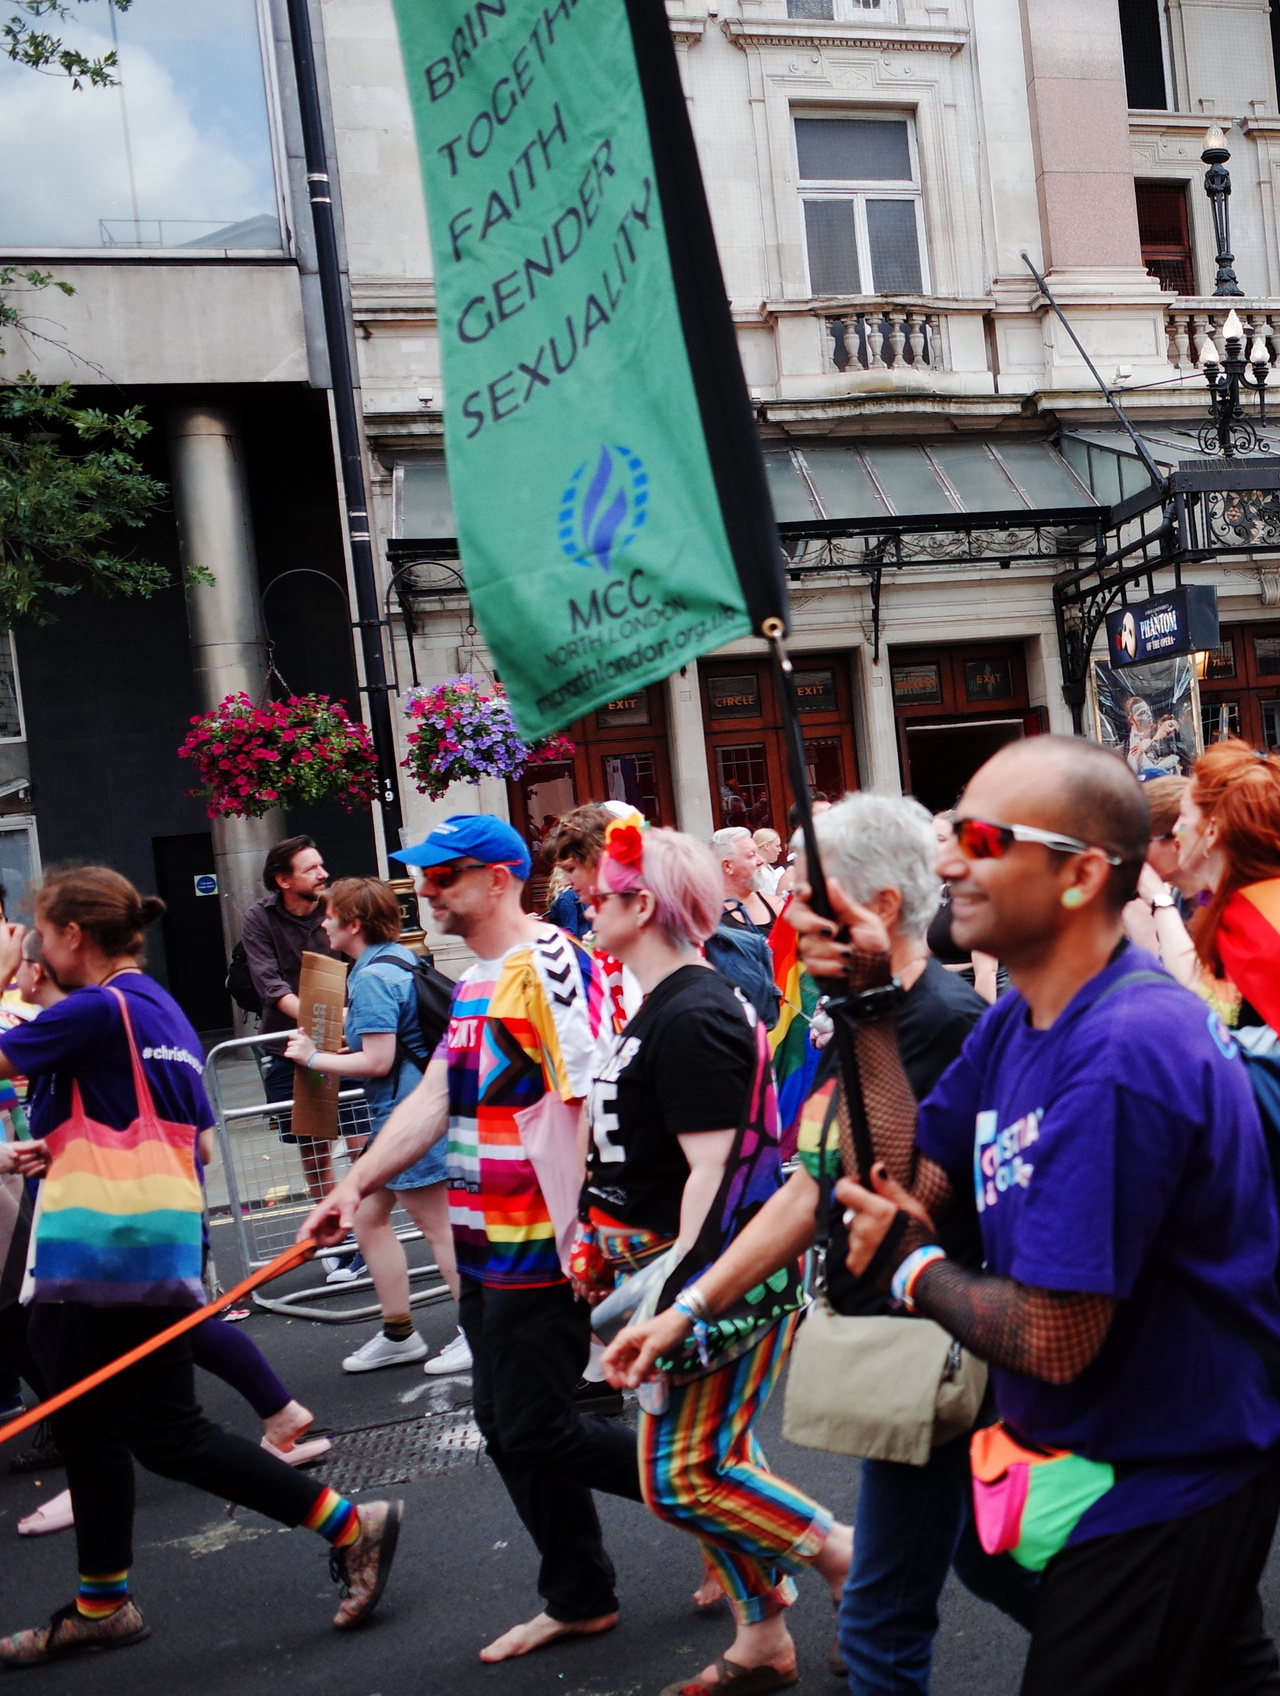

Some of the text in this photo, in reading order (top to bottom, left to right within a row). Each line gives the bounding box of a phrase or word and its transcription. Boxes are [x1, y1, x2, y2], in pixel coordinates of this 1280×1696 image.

[437, 0, 578, 177] TOGETH
[449, 102, 568, 262] FAITH
[457, 139, 615, 344] GENDER
[461, 176, 651, 439] SEXUALITY
[568, 568, 651, 634] MCC
[1139, 610, 1178, 639] PHANTOM
[1146, 643, 1152, 651] OF
[1152, 641, 1160, 650] THE
[797, 685, 825, 696] EXIT
[977, 674, 1002, 685] EXIT
[608, 699, 637, 710] EXIT
[714, 696, 755, 708] CIRCLE
